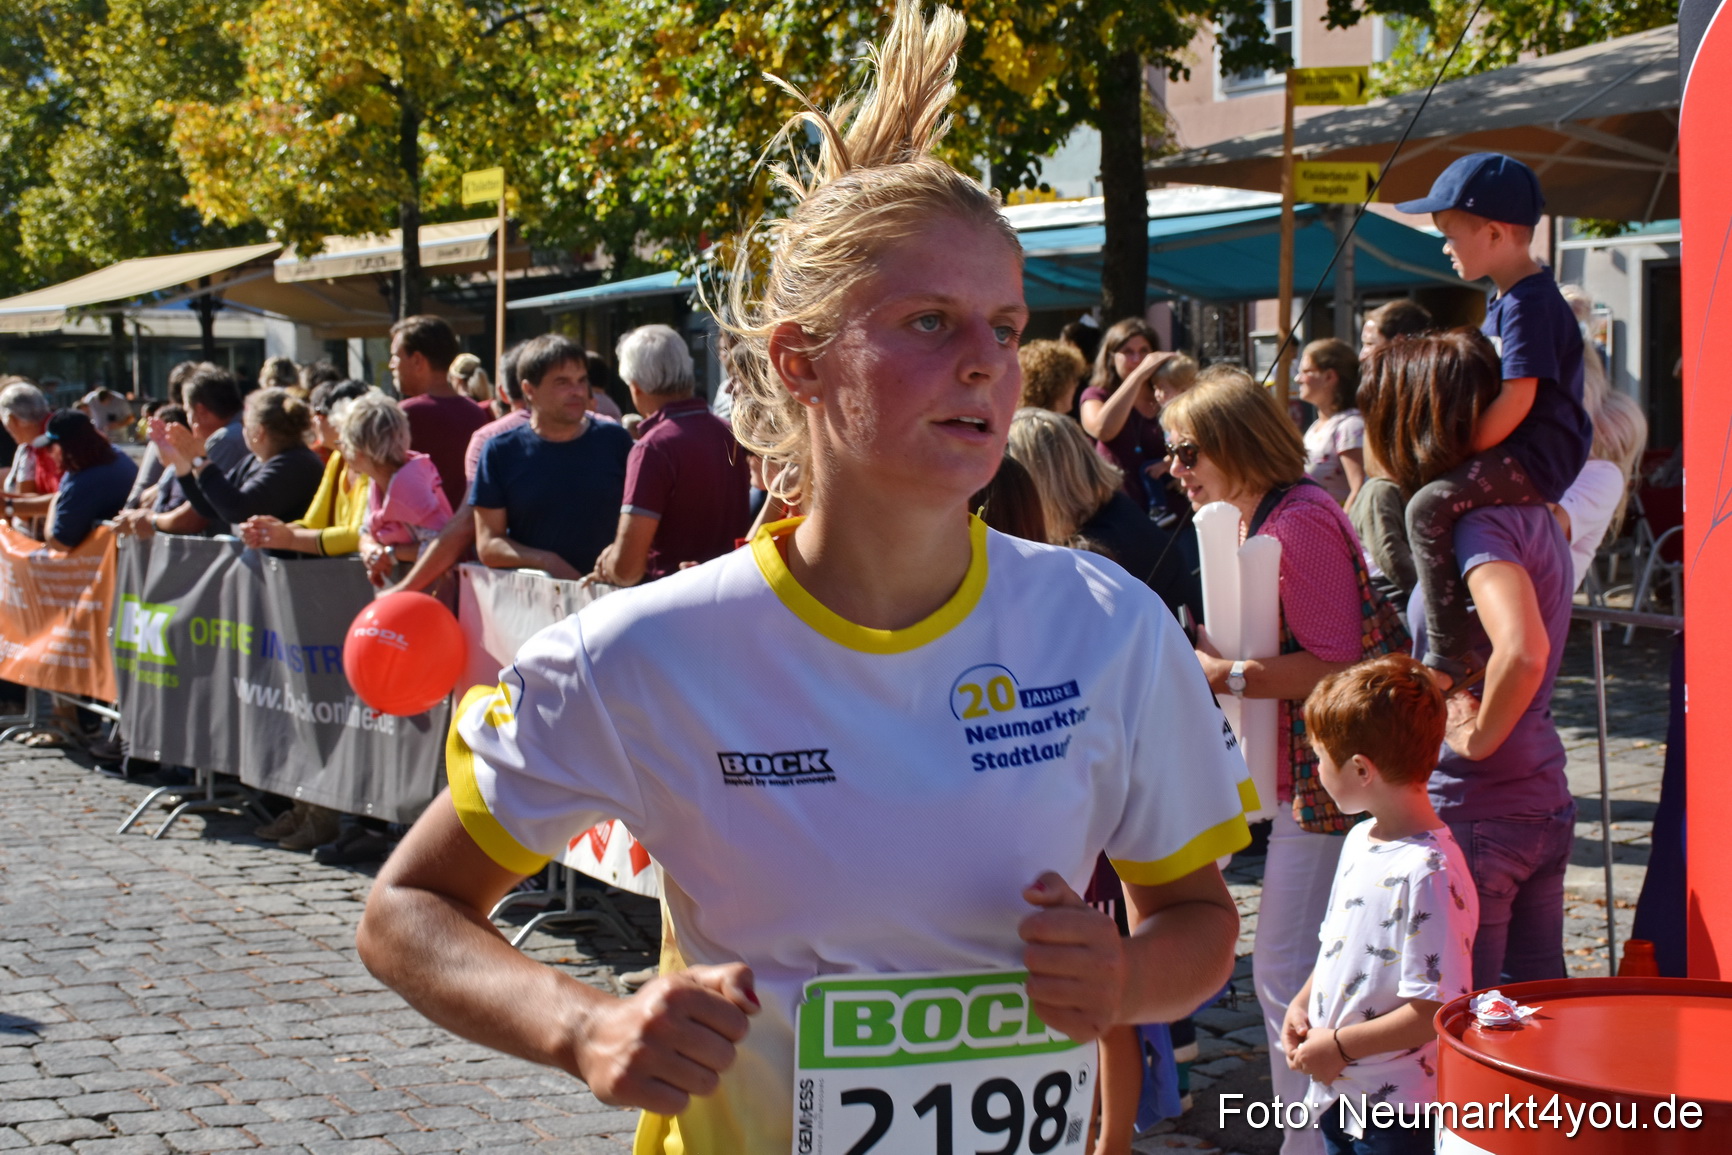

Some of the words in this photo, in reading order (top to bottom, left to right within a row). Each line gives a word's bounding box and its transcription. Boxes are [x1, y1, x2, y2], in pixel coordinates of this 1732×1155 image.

[957, 675, 1016, 720] 20
[1025, 683, 1075, 707] JAHRE
[717, 749, 834, 777] BOCK
[840, 1070, 1072, 1155] 2198
